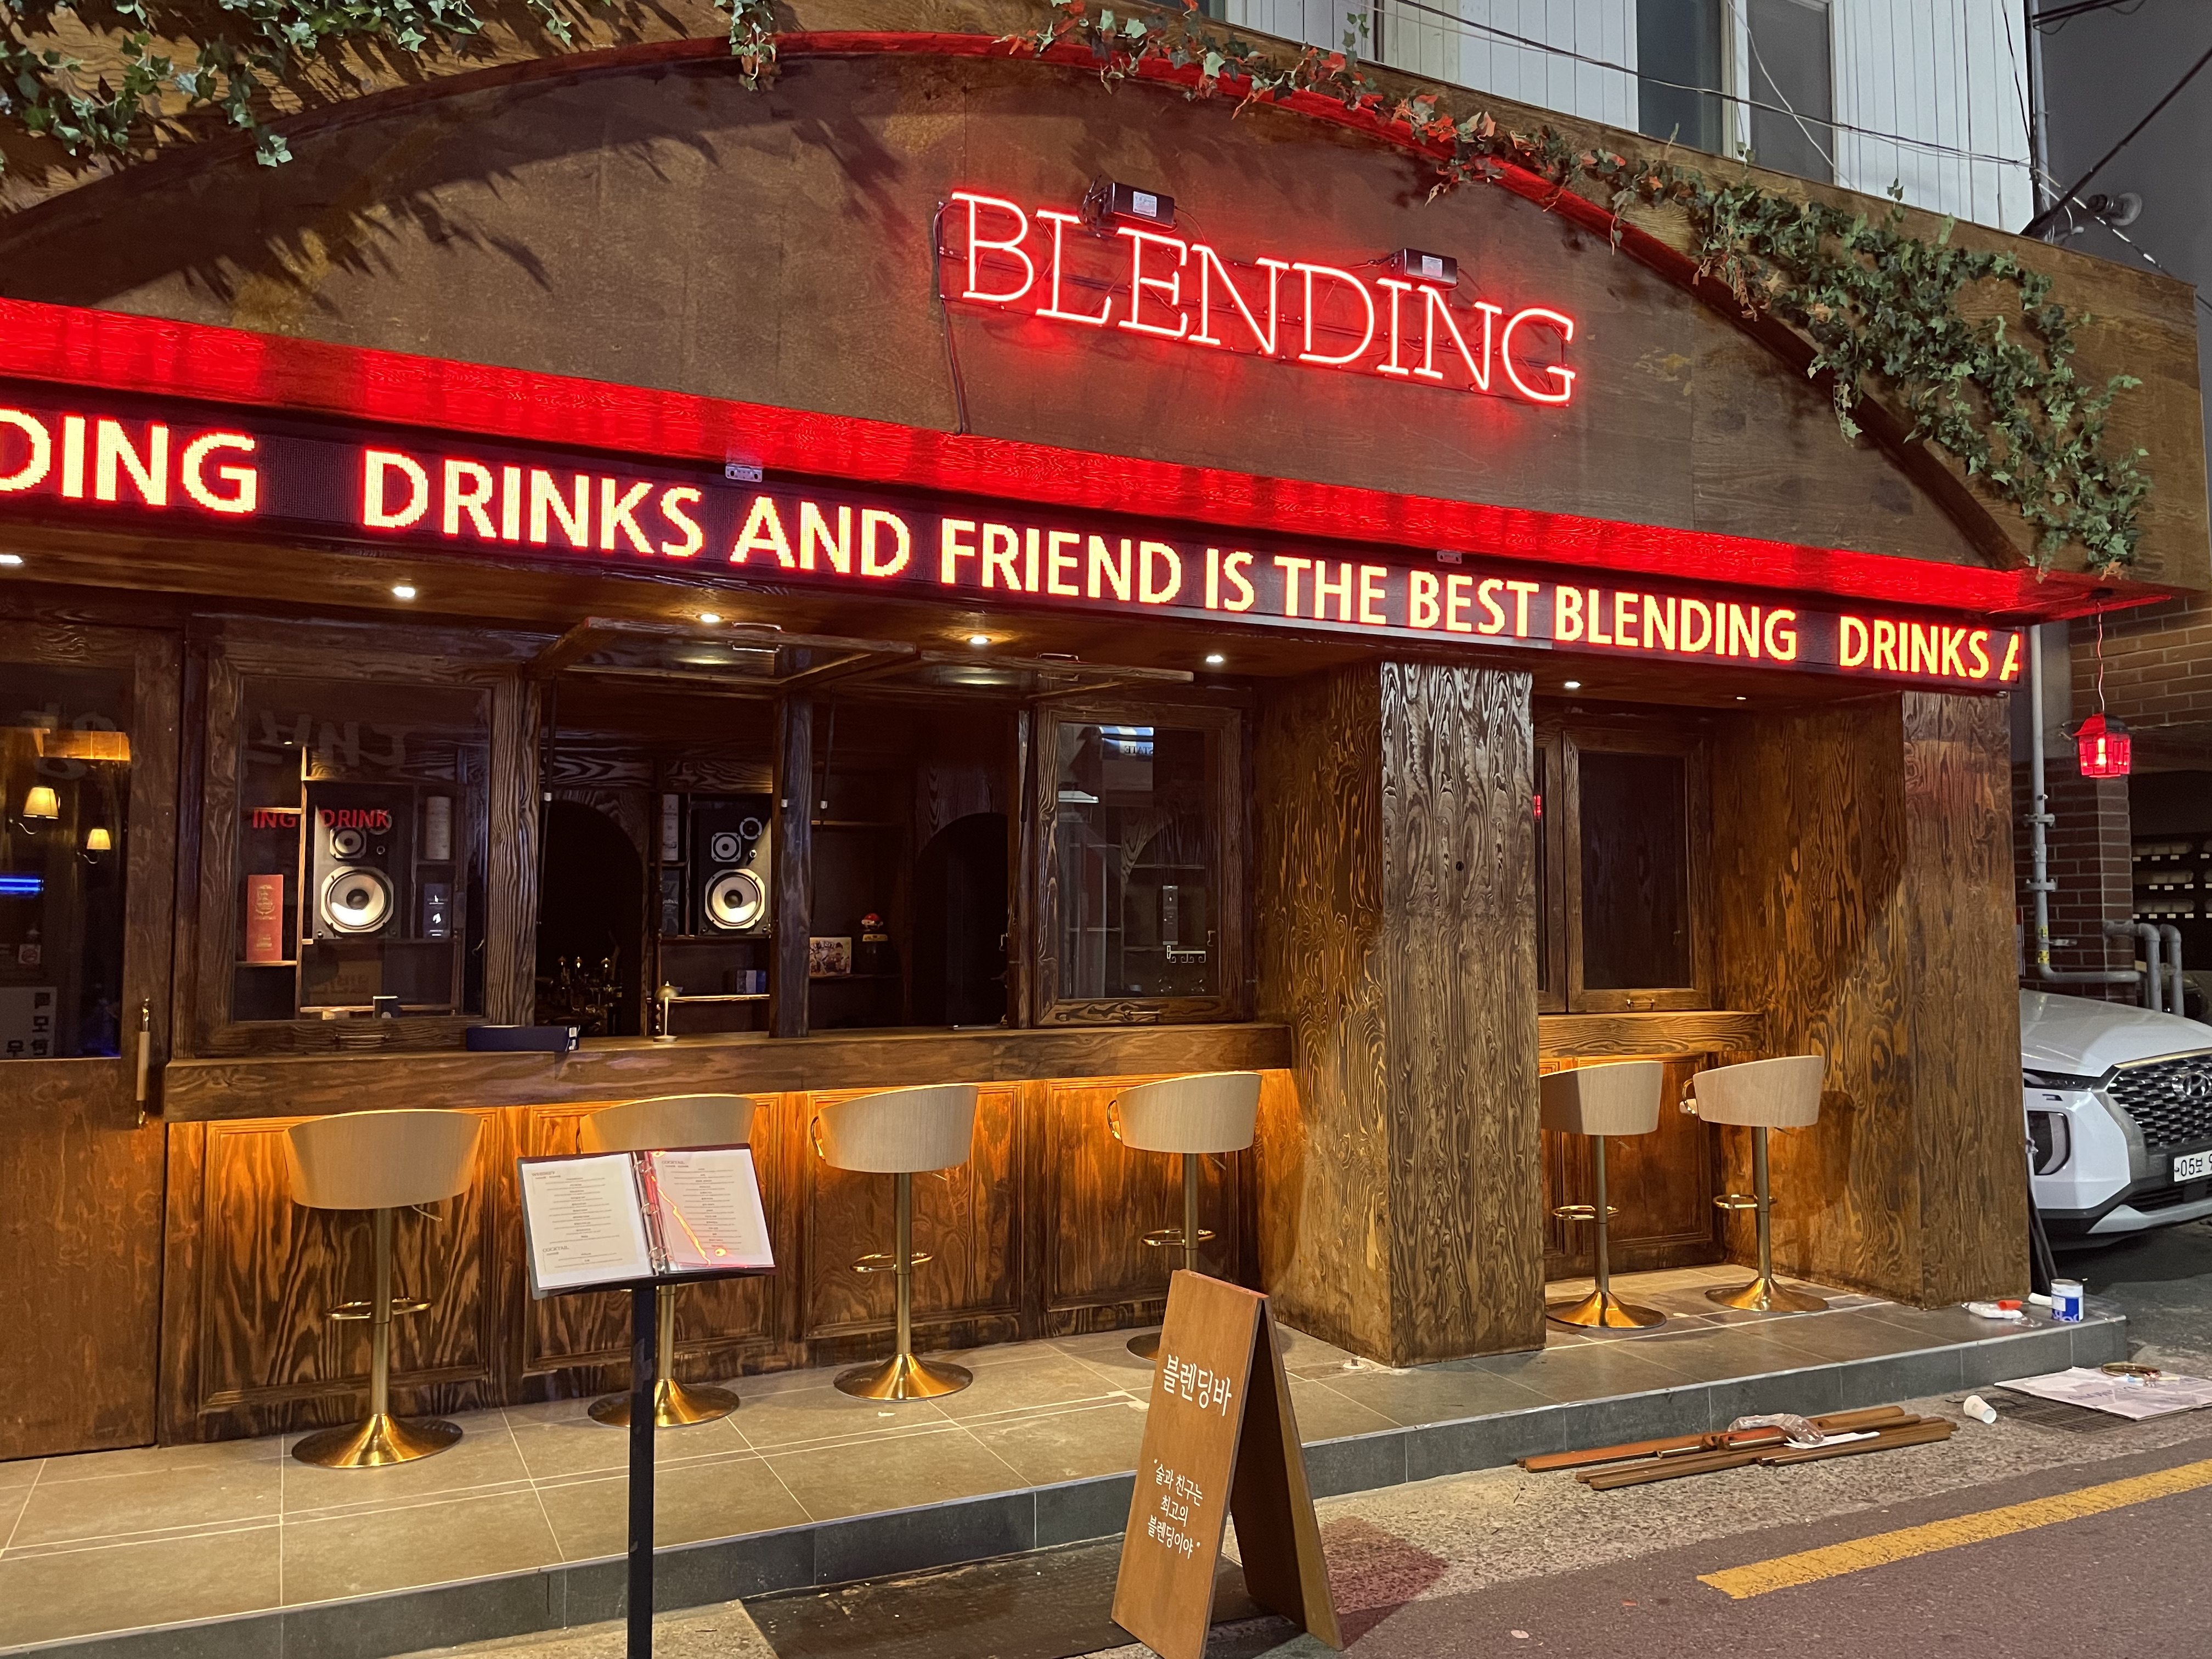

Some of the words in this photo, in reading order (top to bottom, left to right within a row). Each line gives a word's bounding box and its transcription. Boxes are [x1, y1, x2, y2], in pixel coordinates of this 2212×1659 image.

[951, 191, 1577, 403] BLENDING
[0, 409, 258, 514] DING
[363, 450, 703, 557] DRINKS
[729, 495, 911, 577] AND
[941, 517, 1182, 604] FRIEND
[1205, 547, 1255, 612] IS
[1273, 555, 1387, 625] THE
[1409, 570, 1540, 637] BEST
[1555, 585, 1797, 661] BLENDING
[1839, 616, 1990, 679] DRINKS
[1163, 1353, 1232, 1417] 블렌딩바
[1160, 1494, 1189, 1528] 최고의
[1175, 1474, 1204, 1508] 친구는
